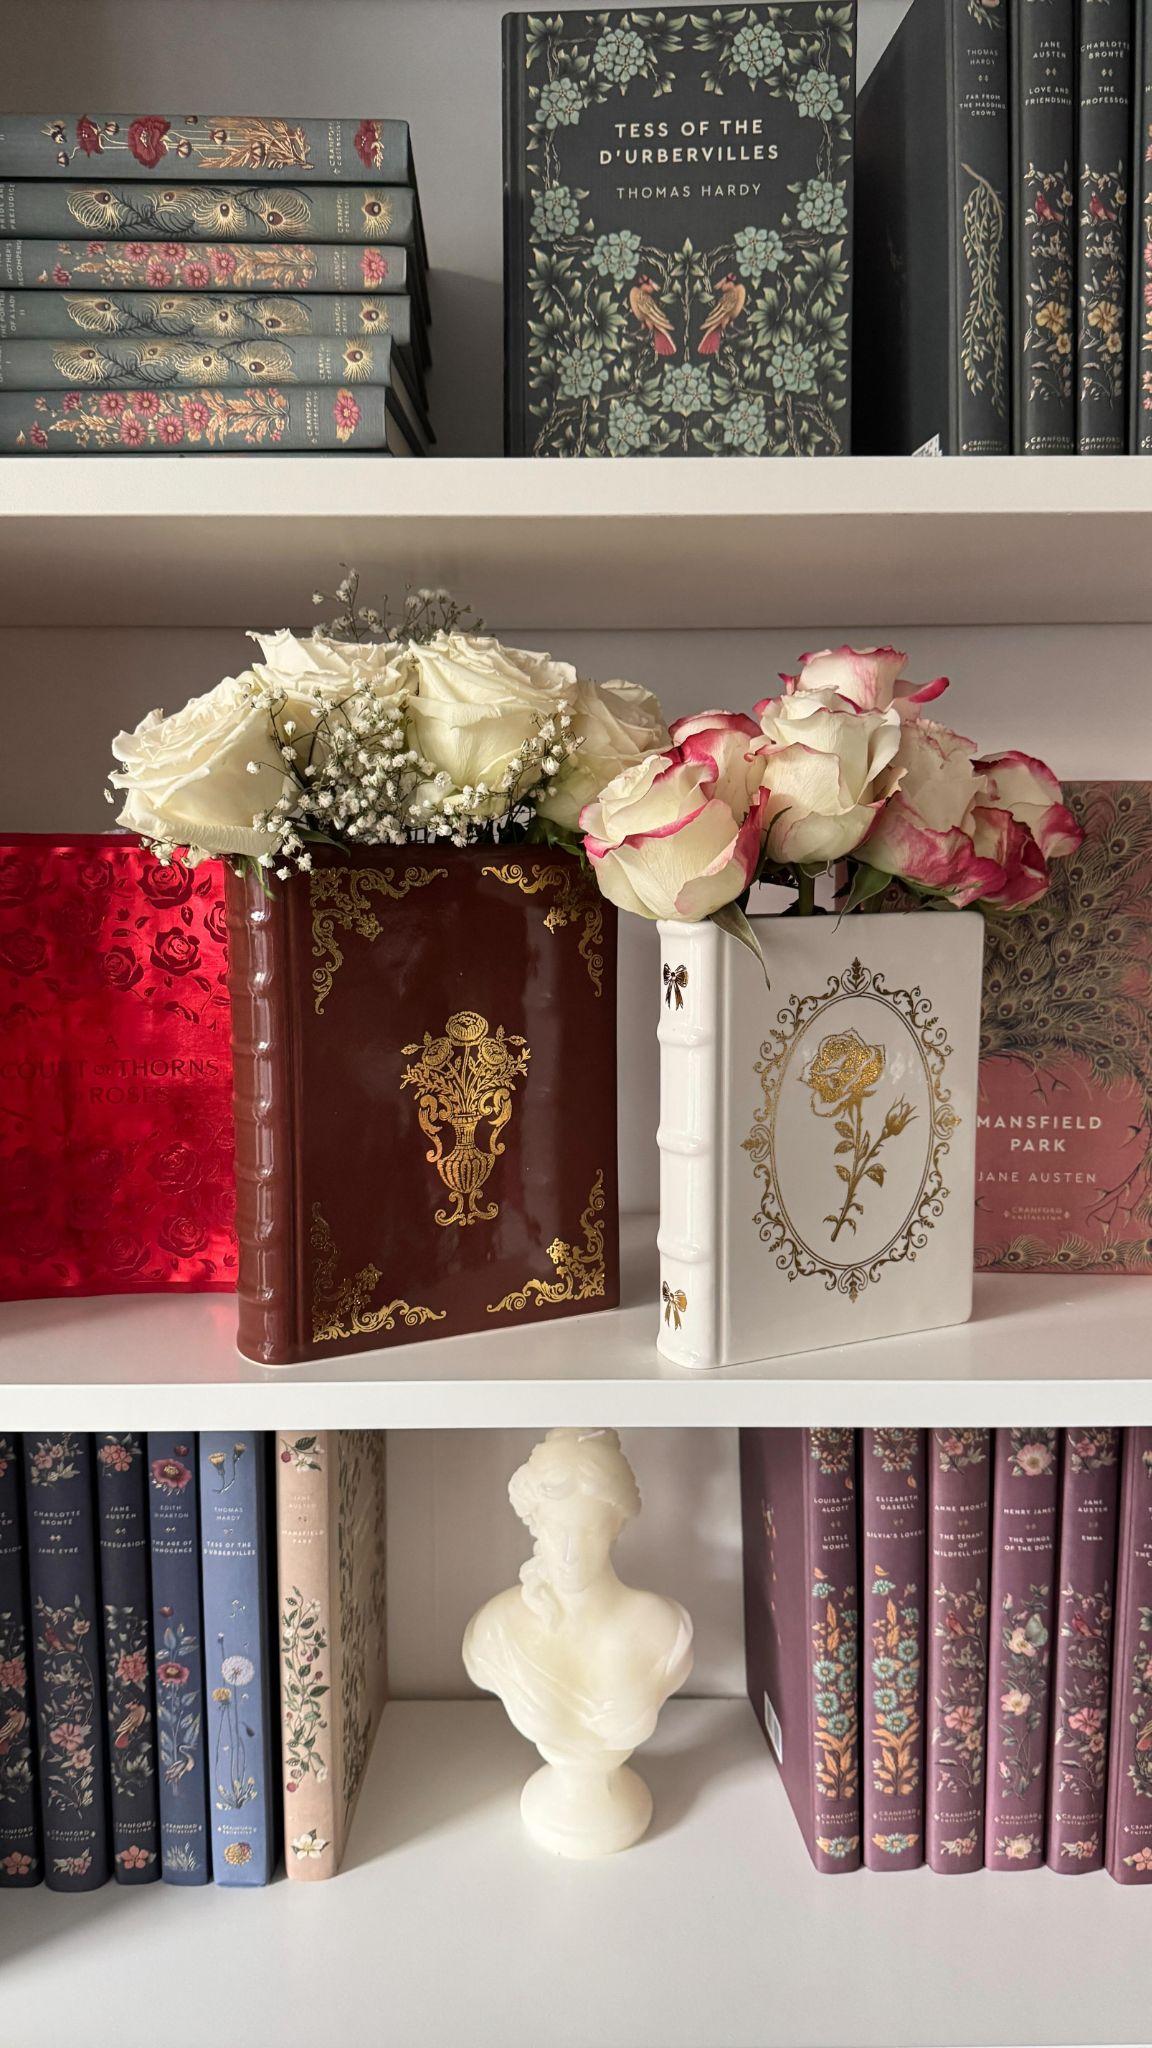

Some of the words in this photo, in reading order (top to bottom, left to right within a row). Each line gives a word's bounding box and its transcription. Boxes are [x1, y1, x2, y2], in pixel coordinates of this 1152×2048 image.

[967, 49, 999, 57] THOMAS
[1029, 86, 1051, 95] LOVE
[1055, 86, 1070, 94] AND
[614, 122, 669, 138] TESS
[681, 120, 710, 136] OF
[719, 119, 763, 135] THE
[600, 145, 778, 165] D'URBERVILLES
[616, 185, 691, 199] THOMAS
[701, 183, 761, 197] HARDY
[104, 1034, 119, 1049] A
[115, 1058, 220, 1079] THORNS
[89, 1086, 170, 1105] ROSES
[977, 1115, 1102, 1130] MANSFIELD
[1010, 1138, 1067, 1152] PARK
[978, 1171, 1020, 1183] JANE
[1028, 1172, 1097, 1184] AUSTEN
[813, 1497, 841, 1505] LOUISA
[876, 1495, 919, 1503] ELIZABETH
[160, 1504, 182, 1512] EDITH
[821, 1505, 849, 1513] ALCOTT
[880, 1503, 915, 1511] GASKELL
[933, 1504, 957, 1512] ANNE
[33, 1510, 80, 1519] CHARLOTTE
[823, 1534, 848, 1542] LITTLE
[939, 1533, 954, 1541] THE
[1026, 1535, 1051, 1543] WINGS
[1081, 1534, 1104, 1542] EMMA
[152, 1539, 165, 1547] THE
[166, 1540, 181, 1548] AGE
[207, 1540, 223, 1548] TESS
[225, 1541, 236, 1549] OF
[821, 1543, 850, 1551] WOMEN
